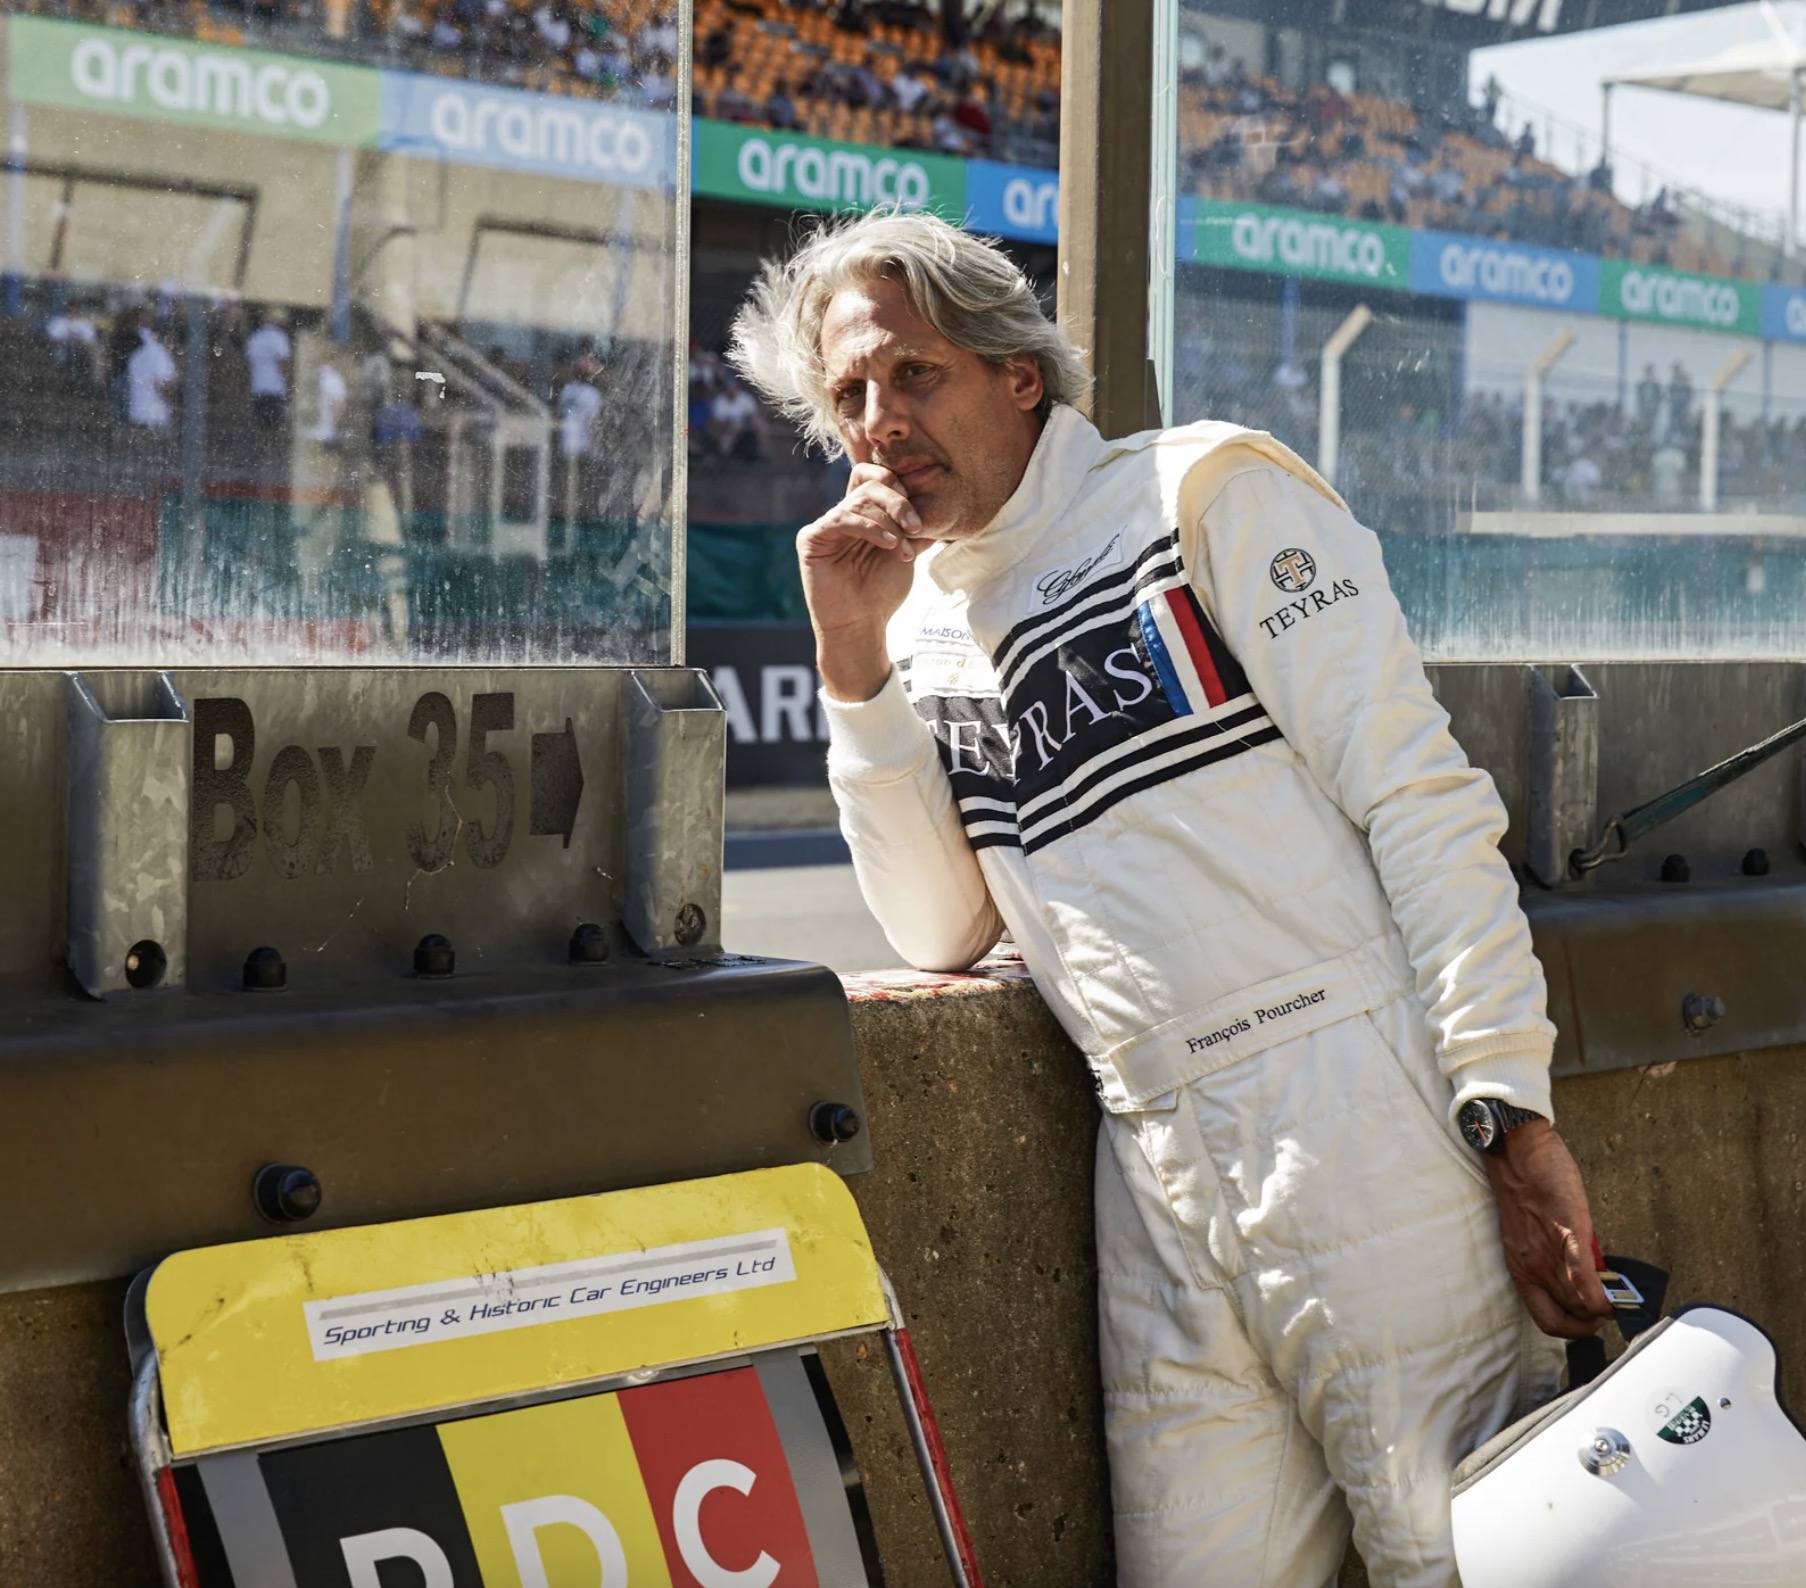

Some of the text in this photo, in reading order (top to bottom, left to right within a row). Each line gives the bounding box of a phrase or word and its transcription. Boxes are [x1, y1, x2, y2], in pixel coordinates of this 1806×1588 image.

[71, 38, 331, 128] aramco
[432, 93, 650, 173] aramco
[738, 138, 929, 211] aramco
[1002, 178, 1059, 231] ar
[1233, 213, 1386, 277] aramco
[1440, 245, 1574, 302] aramco
[1621, 270, 1739, 325] aramco
[1259, 578, 1360, 639] TEYRAS
[406, 691, 515, 873] 35
[1185, 989, 1326, 1054] François Pourcher
[323, 1256, 776, 1345] Sporting & Historic Car Engineers Ltd
